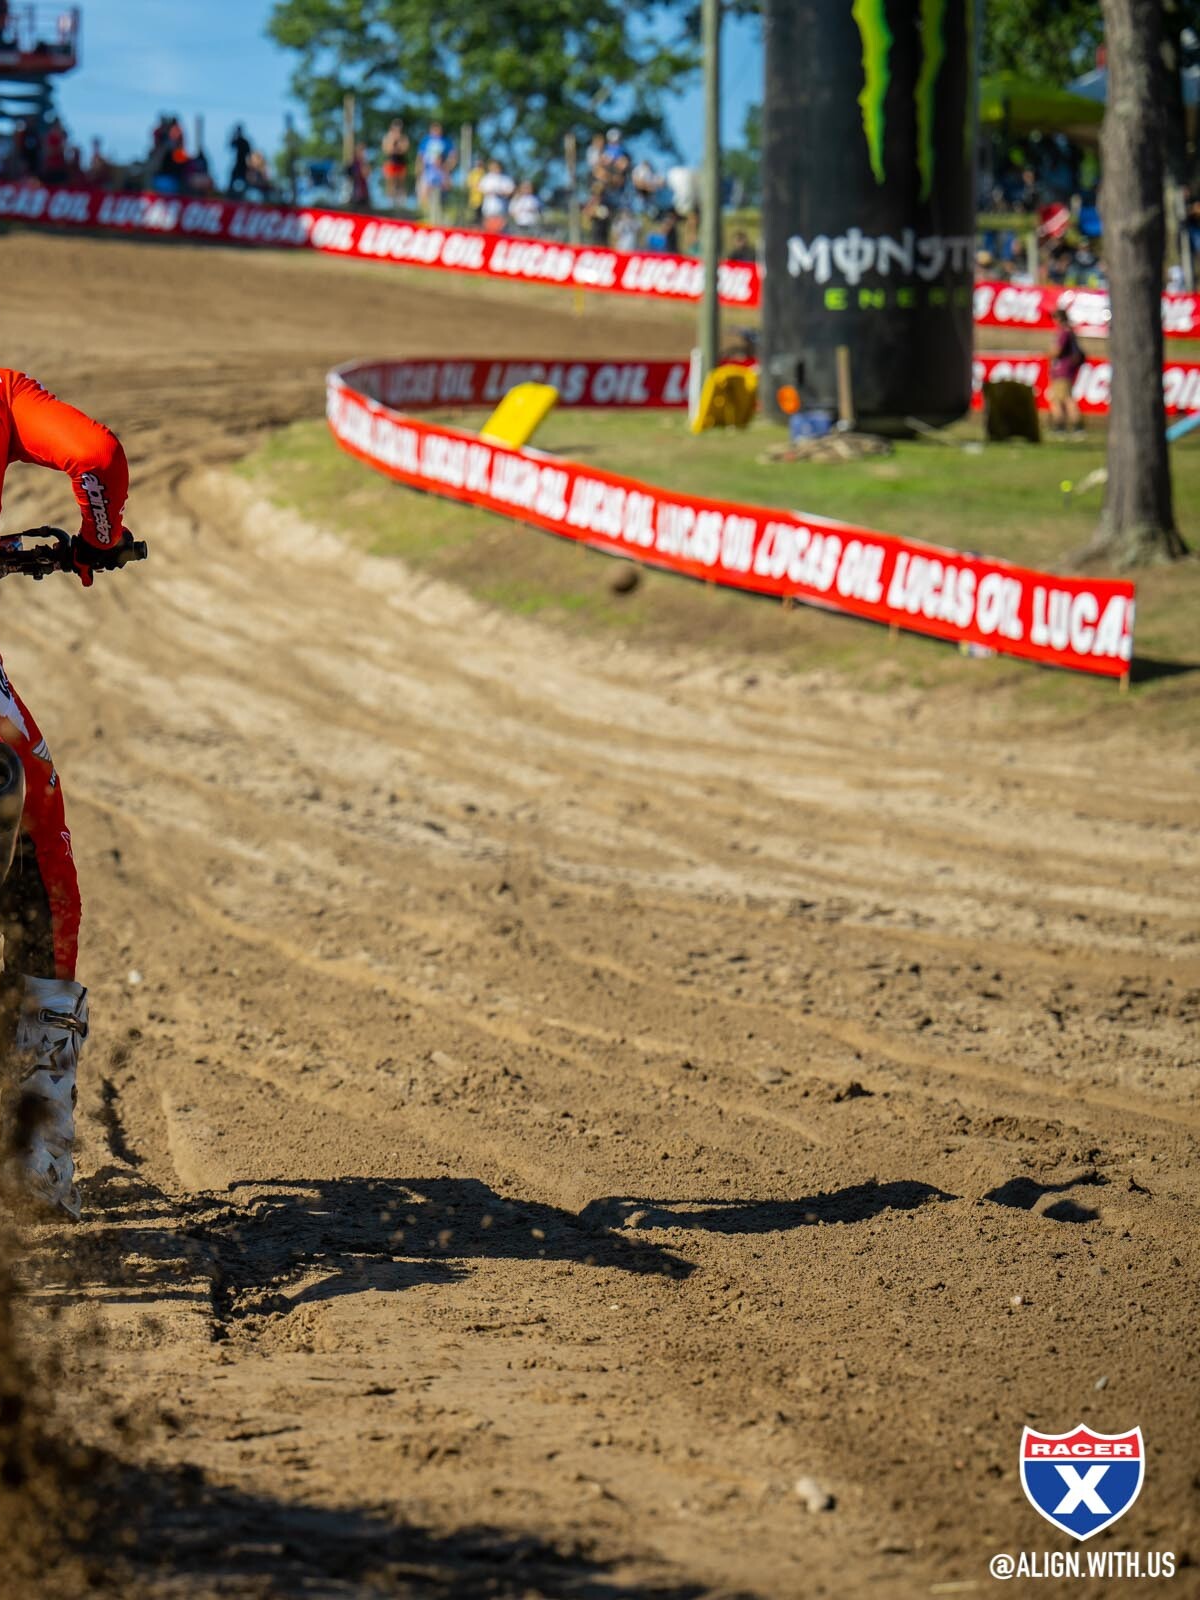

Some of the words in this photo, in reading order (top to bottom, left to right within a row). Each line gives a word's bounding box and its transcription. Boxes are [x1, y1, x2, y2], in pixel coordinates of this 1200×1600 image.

[48, 189, 91, 222] OIL
[97, 195, 181, 231] LUCAS
[182, 203, 224, 234] OIL
[228, 207, 314, 244] LUCAS
[310, 214, 354, 250] OIL
[358, 221, 446, 265] LUCAS
[441, 233, 486, 270] OIL
[489, 239, 576, 282] LUCAS
[572, 250, 618, 288] OIL
[992, 286, 1044, 325] OIL
[590, 365, 650, 398] OIL
[623, 491, 656, 548] OIL
[656, 502, 725, 566] LUCAS
[721, 514, 757, 573] OIL
[753, 521, 843, 592] LUCAS
[837, 540, 886, 603] OIL
[887, 551, 977, 629] LUCAS
[976, 573, 1024, 641] OIL
